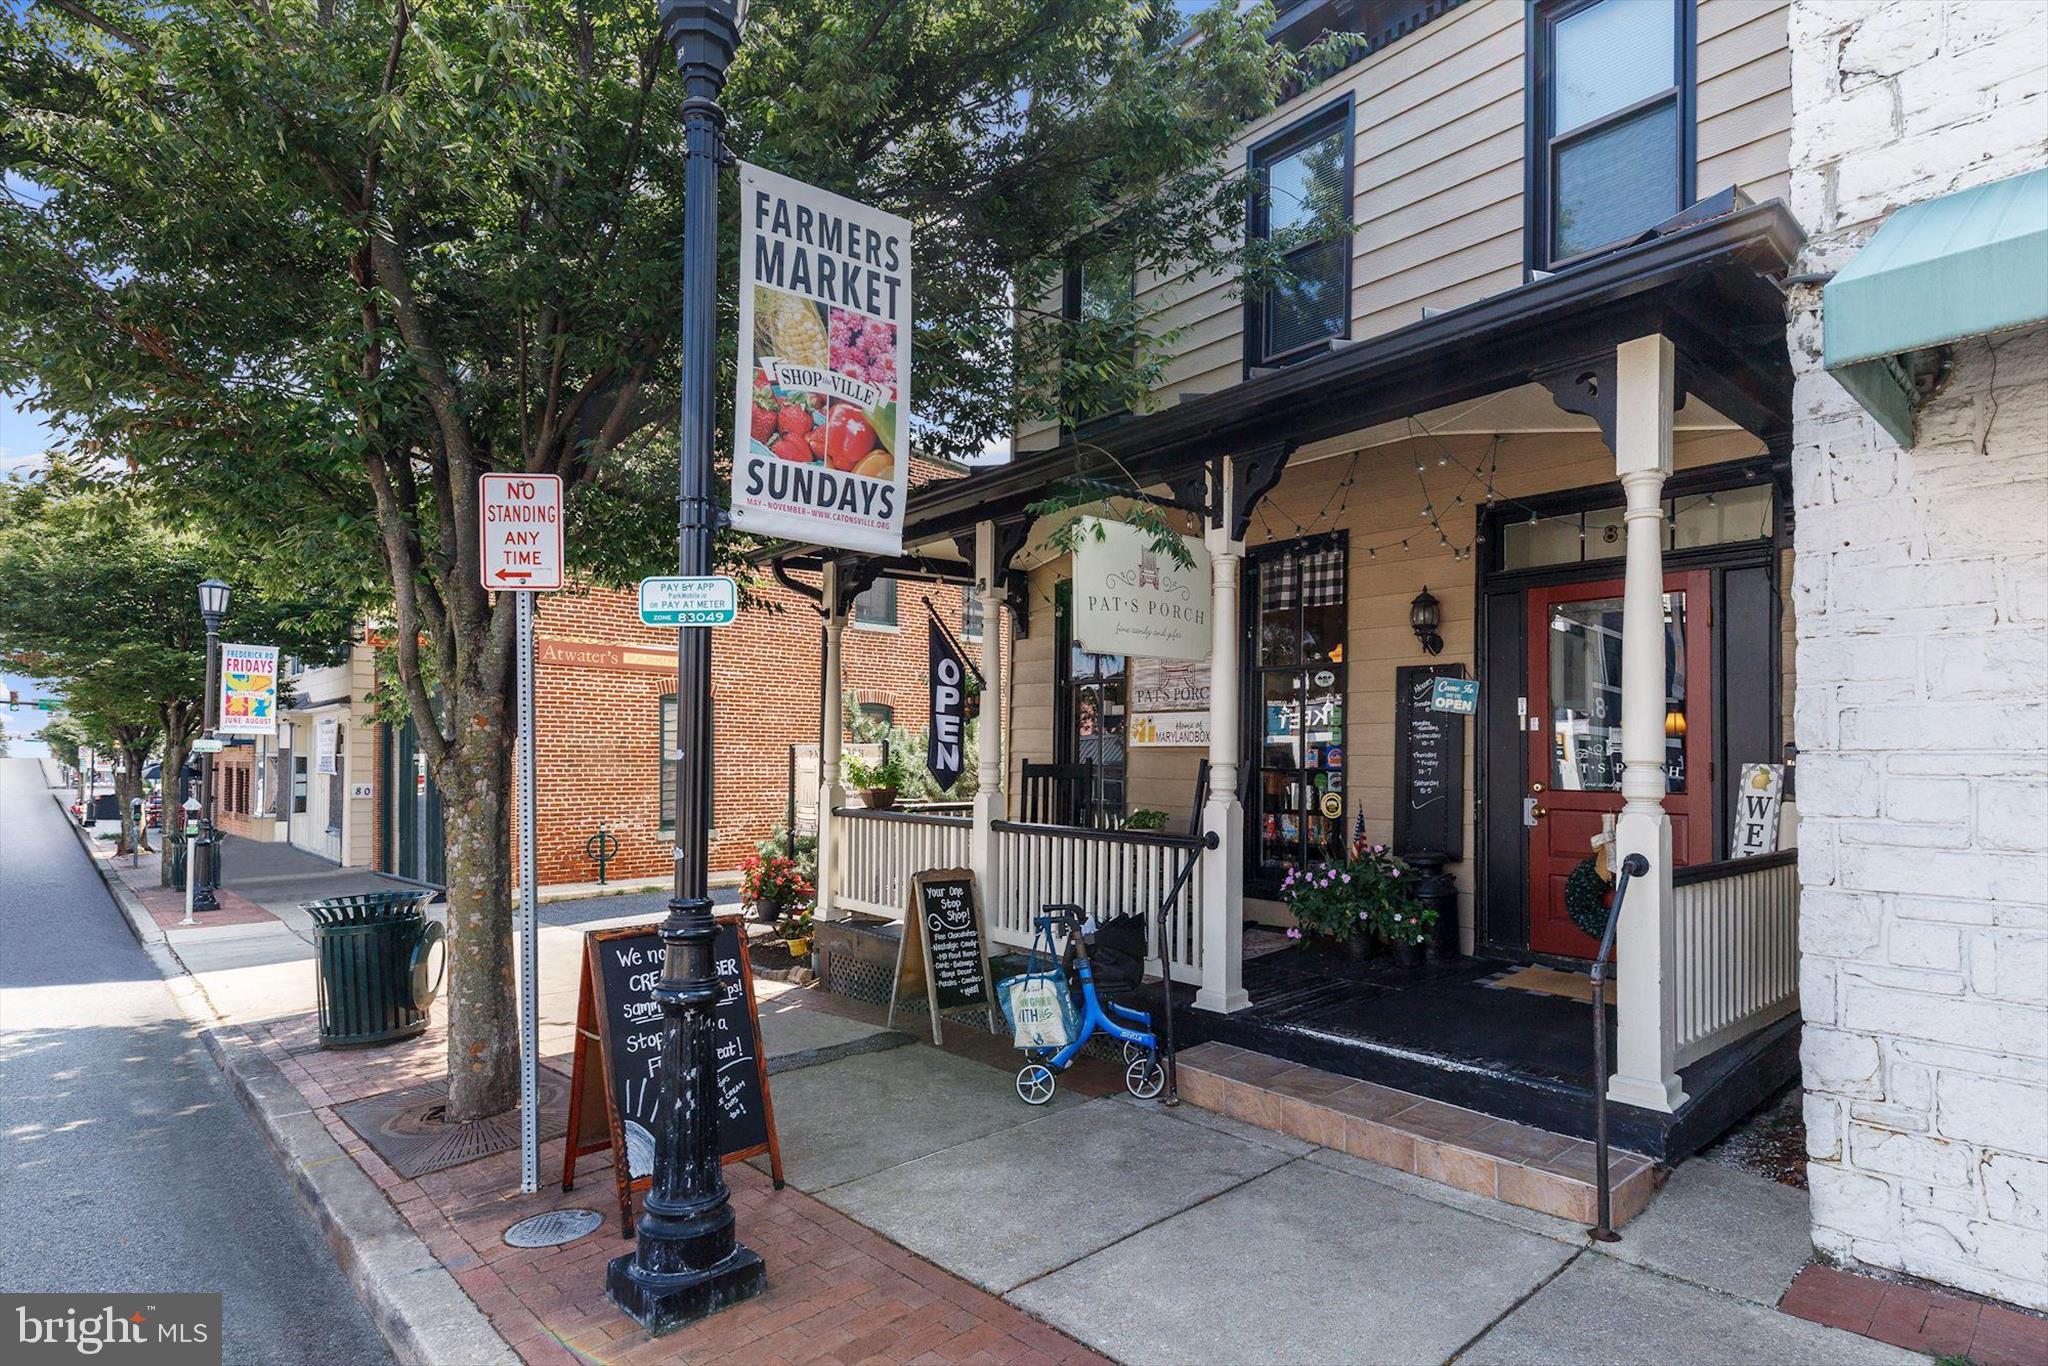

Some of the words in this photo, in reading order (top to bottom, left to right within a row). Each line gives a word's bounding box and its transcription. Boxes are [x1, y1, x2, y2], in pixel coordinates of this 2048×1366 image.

[755, 190, 900, 273] FARMERS
[755, 234, 901, 320] MARKET
[781, 368, 823, 388] SHOP
[831, 376, 875, 406] VILLE
[507, 482, 536, 500] NO
[746, 458, 895, 520] SUNDAYS
[487, 504, 556, 523] STANDING
[504, 531, 540, 546] ANY
[503, 551, 543, 565] TIME
[660, 583, 679, 592] PAY
[696, 583, 715, 591] APP
[661, 601, 680, 609] PAY
[682, 601, 694, 609] AT
[696, 600, 725, 609] METER
[677, 612, 725, 622] 83049
[1149, 600, 1204, 625] PORCH
[227, 650, 263, 659] FREDERICK
[542, 645, 619, 665] Atwater's
[226, 658, 273, 673] FRIDAYS
[1173, 686, 1210, 701] PORC
[1438, 681, 1461, 693] Come
[1462, 683, 1474, 694] In
[1435, 697, 1472, 711] OPEN
[935, 658, 960, 772] OPEN
[926, 887, 946, 899] Your
[949, 886, 964, 897] One
[941, 899, 961, 911] Stop
[947, 908, 970, 923] Shop!
[934, 933, 947, 941] Fine
[615, 946, 643, 968] We
[647, 948, 666, 964] no
[948, 951, 961, 960] Food
[629, 970, 664, 992] CRE
[623, 1001, 662, 1018] samm
